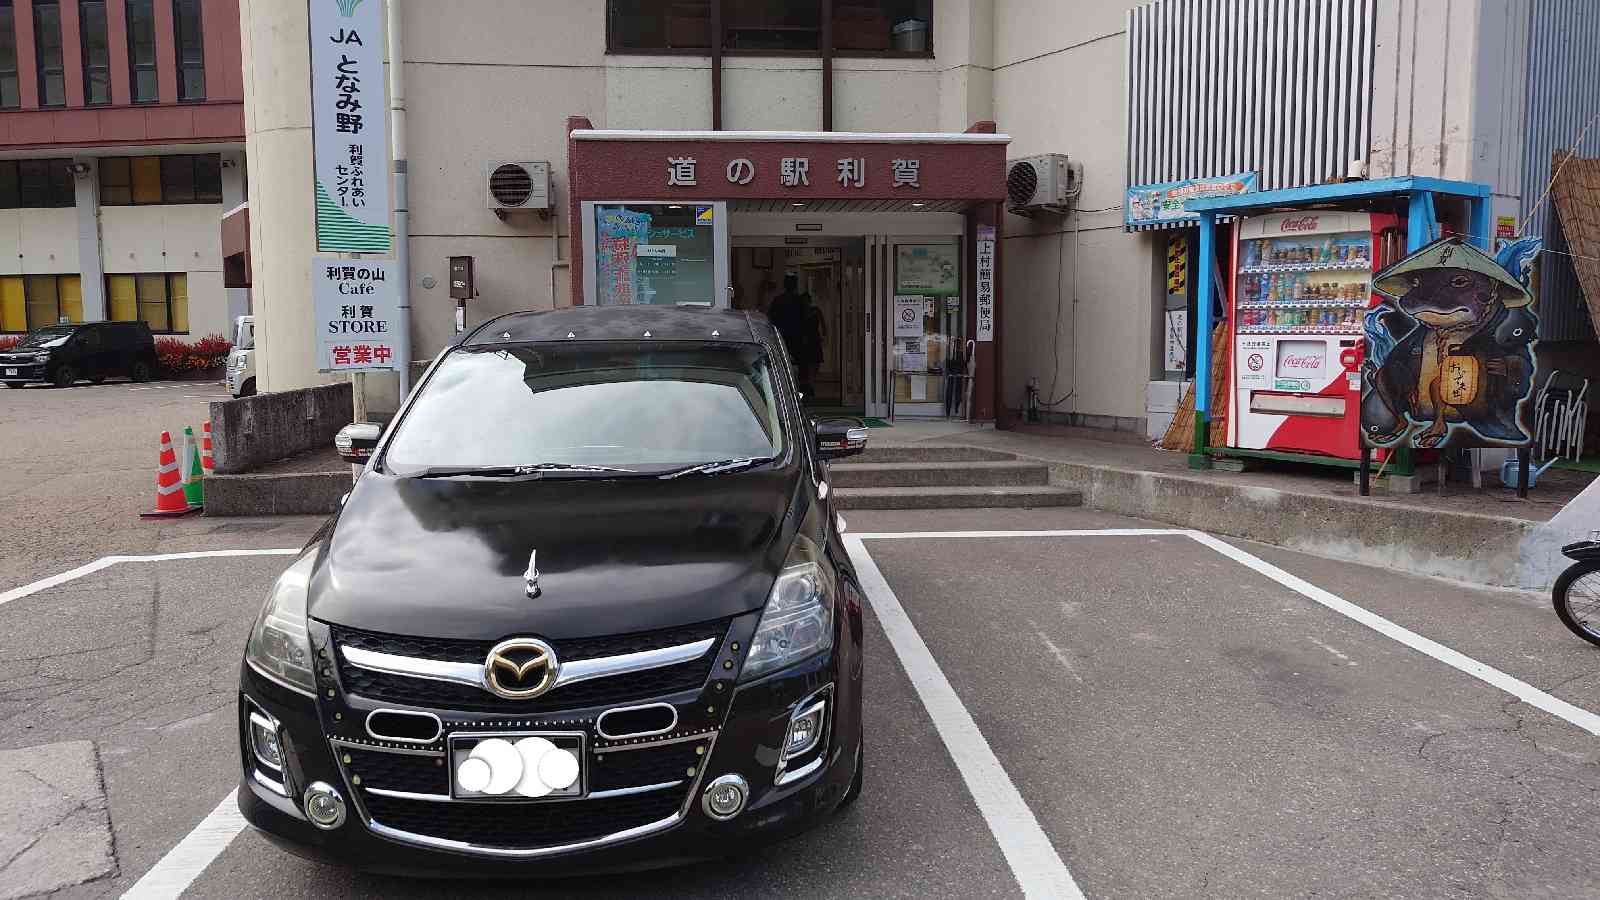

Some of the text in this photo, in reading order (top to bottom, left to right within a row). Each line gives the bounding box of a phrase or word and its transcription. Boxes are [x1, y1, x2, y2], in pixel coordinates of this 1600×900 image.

[330, 29, 363, 46] JA
[335, 54, 363, 134] となみ野
[348, 144, 366, 208] 利賀ふれあい
[667, 156, 921, 188] 道の駅利賀
[335, 164, 349, 207] センター
[1280, 215, 1319, 233] Coca-Cola
[326, 266, 385, 281] 利賀の山
[338, 282, 375, 295] Café
[341, 305, 374, 319] 利賀
[328, 320, 388, 333] STORE
[333, 345, 391, 364] 営業中
[1283, 354, 1321, 369] Coca-Cola
